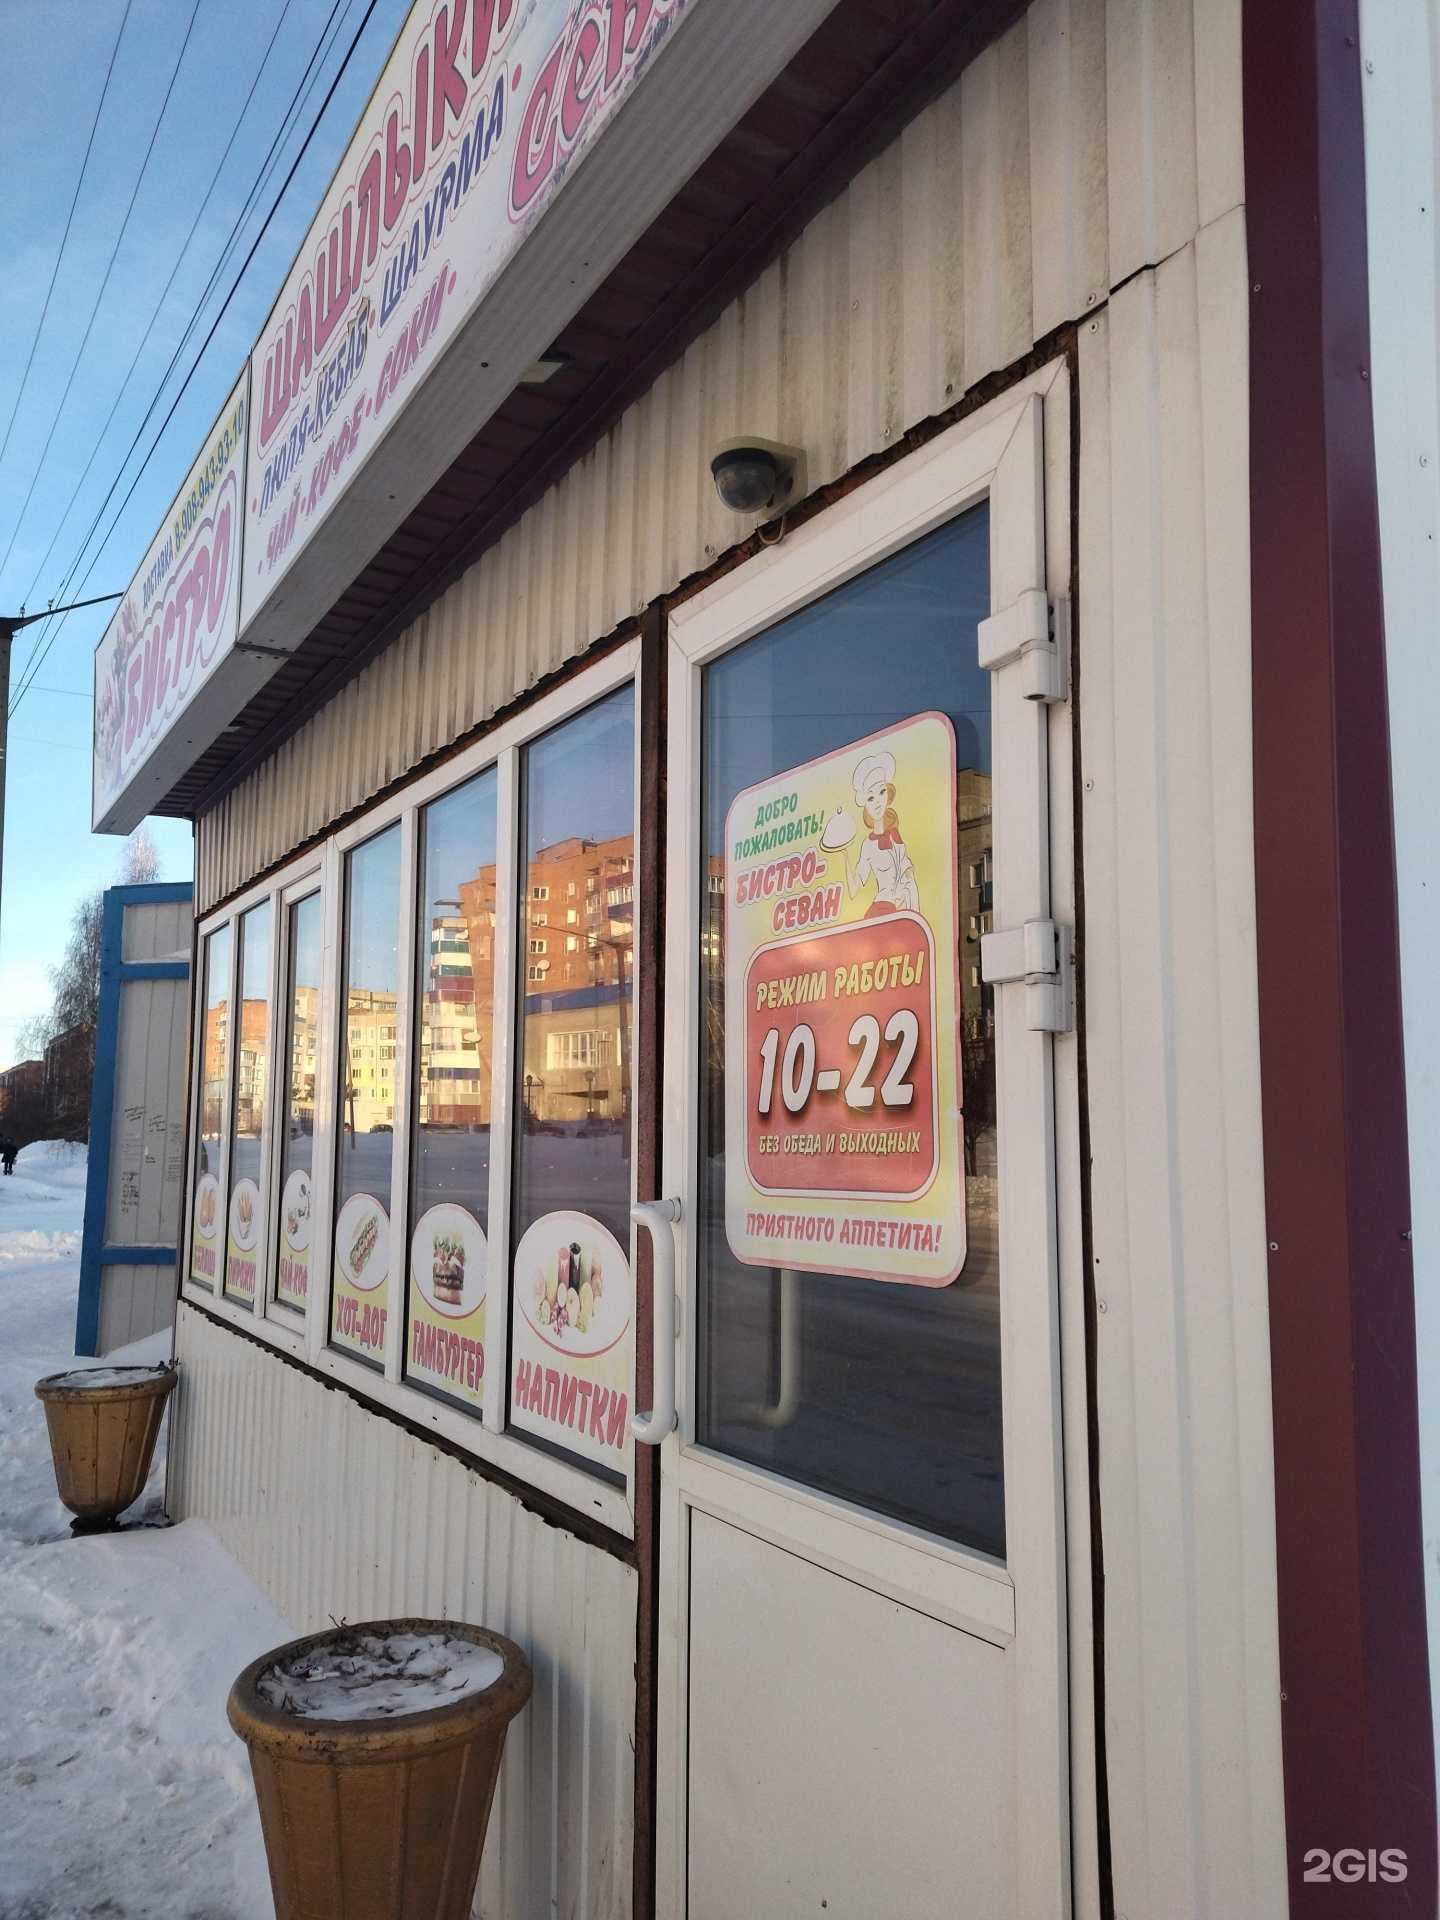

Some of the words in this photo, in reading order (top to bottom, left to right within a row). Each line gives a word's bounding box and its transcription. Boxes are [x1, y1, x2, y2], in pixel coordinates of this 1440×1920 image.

[380, 74, 504, 328] ШАУРМА
[266, 481, 302, 571] ЧАЙ
[306, 392, 365, 516] КОФЕ
[375, 264, 449, 415] СОКИ
[143, 534, 175, 608] ДОСТАВКА
[125, 502, 231, 754] БИСТРО
[735, 810, 825, 861] ПОЖАЛОВАТЬ!
[754, 792, 798, 829] ДОБРО
[736, 851, 826, 903] БИСТРО-
[773, 886, 841, 931] СЕВАН
[756, 970, 828, 1011] РЕЖИМ
[834, 951, 925, 997] РАБОТЫ
[758, 1009, 920, 1114] 10-22
[759, 1134, 780, 1153] БЕЗ
[784, 1133, 821, 1156] ОБЕДА
[825, 1132, 836, 1153] И
[839, 1131, 921, 1156] ВЫХОДНЫХ
[746, 1212, 835, 1243] ПРИЯТНОГО
[839, 1218, 943, 1253] АППЕТИТА!
[336, 1294, 388, 1350] ХОТ-ДОГ
[412, 1319, 485, 1392] ГАМБУРГЕР
[515, 1358, 628, 1450] НАПИТКИ
